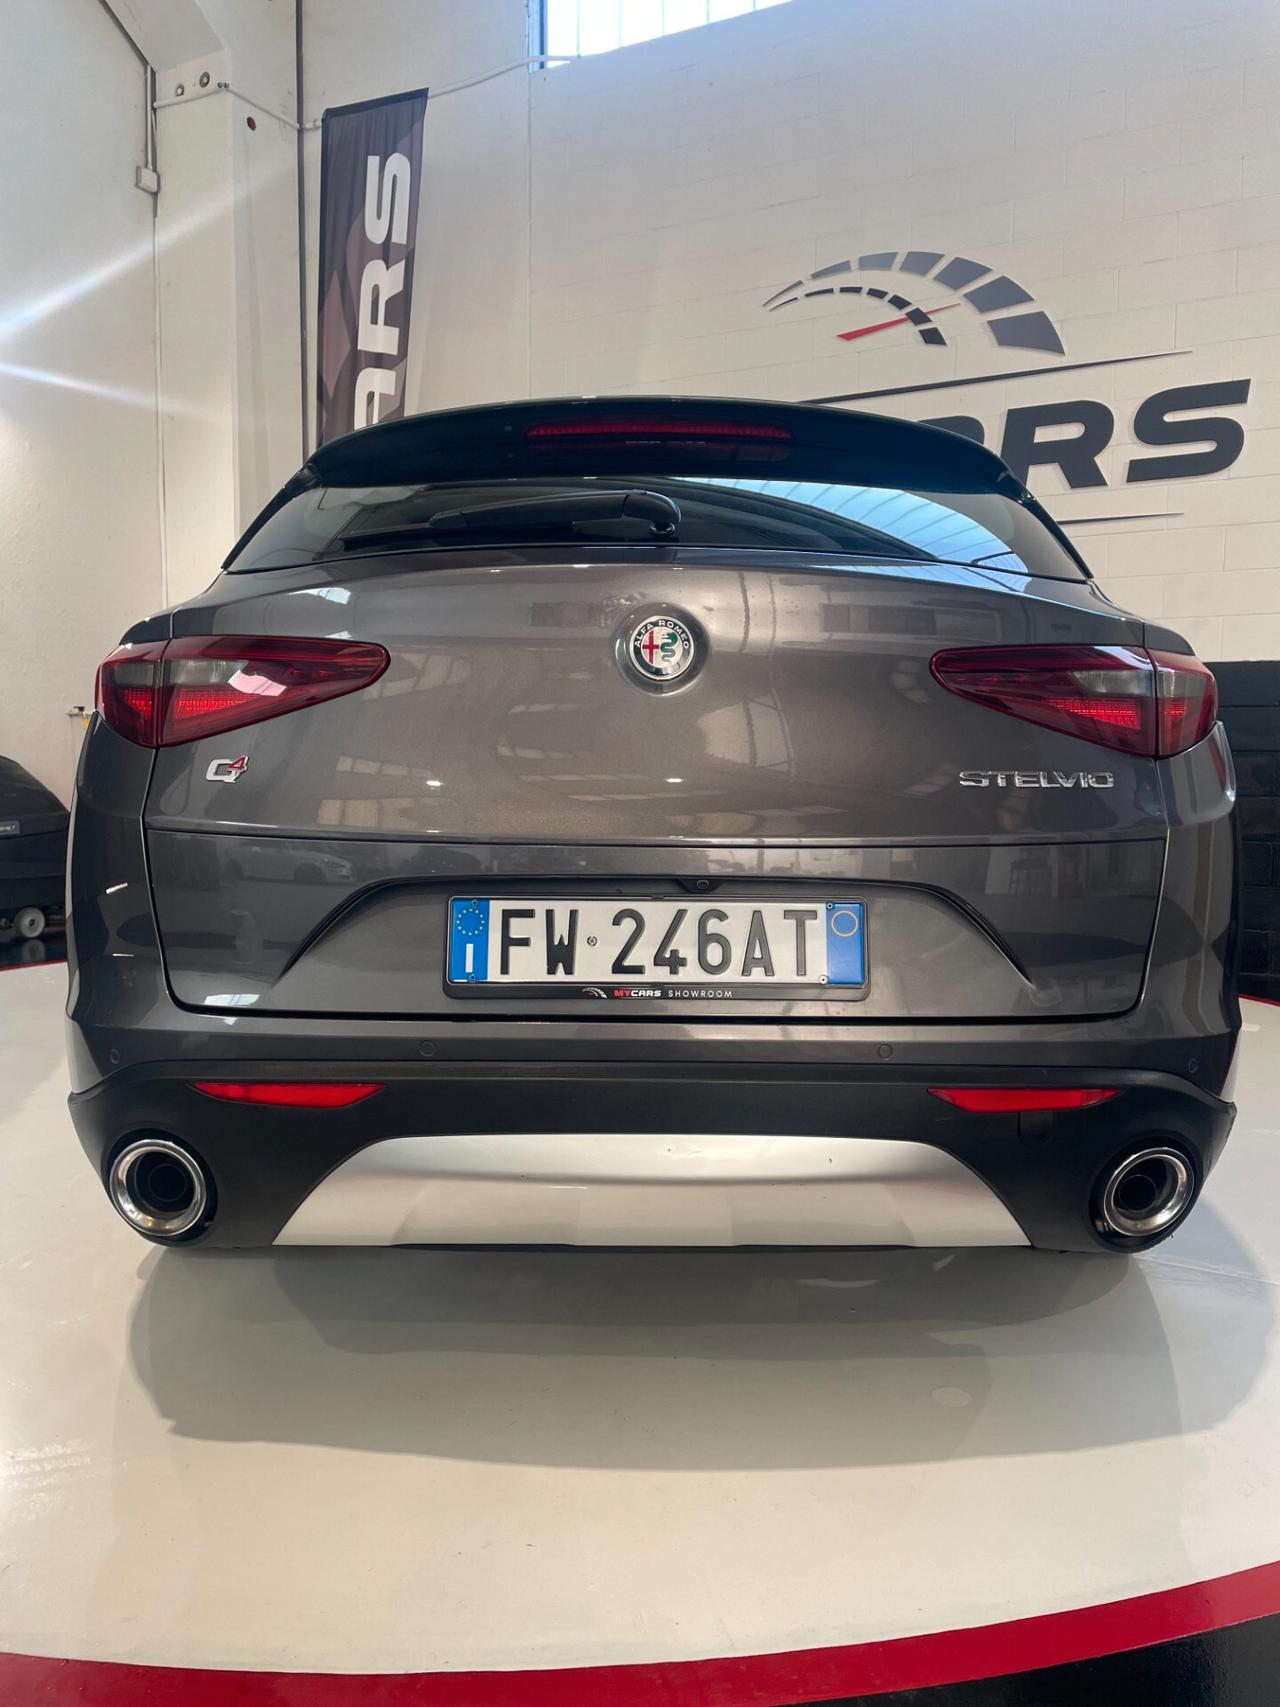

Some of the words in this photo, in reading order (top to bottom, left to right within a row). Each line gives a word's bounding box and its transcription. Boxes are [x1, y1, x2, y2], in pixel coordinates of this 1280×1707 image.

[634, 623, 654, 648] ALFA
[658, 620, 690, 649] ROMEO
[206, 755, 249, 783] Q4
[959, 770, 1115, 788] STELVIO
[500, 908, 580, 975] FW
[611, 908, 818, 977] 246AT
[667, 989, 733, 998] SHOWROOM
